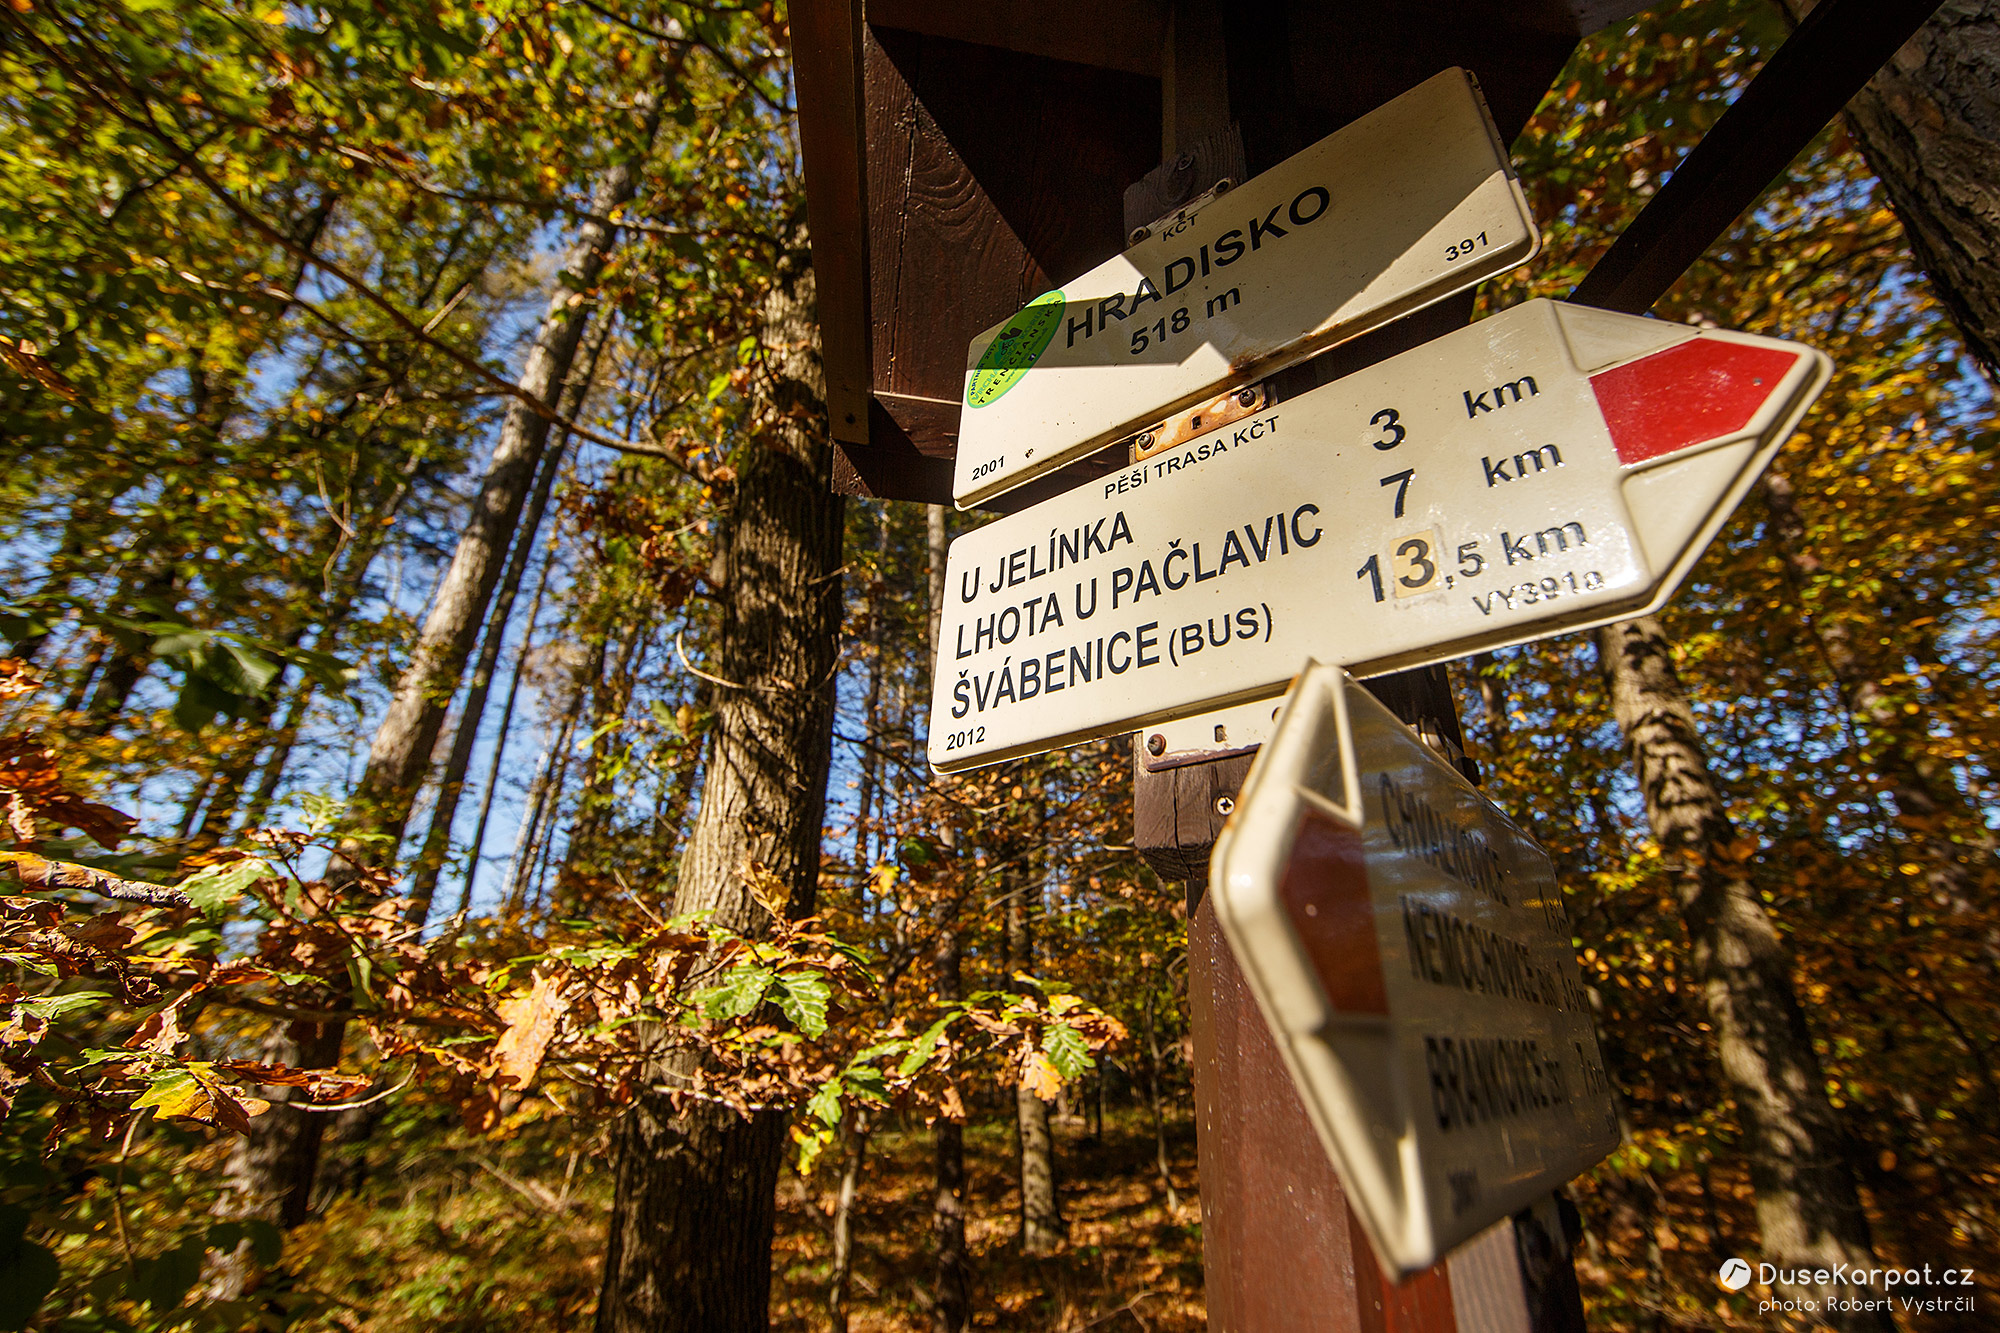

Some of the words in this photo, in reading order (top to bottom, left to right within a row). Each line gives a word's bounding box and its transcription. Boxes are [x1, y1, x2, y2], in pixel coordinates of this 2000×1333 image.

[1162, 212, 1199, 242] KČT
[1444, 231, 1491, 262] 391
[1066, 187, 1331, 349] HRADISKO
[1130, 309, 1190, 356] 518
[1206, 286, 1242, 319] m
[961, 566, 981, 604] U
[989, 511, 1134, 595] JELÍNKA
[1370, 408, 1406, 452] 3
[1463, 375, 1540, 419] km
[971, 456, 1006, 481] 2001
[1104, 467, 1149, 500] PĚŠÍ
[1154, 441, 1229, 477] TRASA
[1233, 415, 1280, 454] KČT
[955, 591, 1064, 661] LHOTA
[1075, 577, 1097, 621] U
[1111, 503, 1324, 610] PAČLAVIC
[1380, 468, 1417, 519] 7
[1481, 442, 1565, 488] km
[950, 620, 1161, 720] ŠVÁBENICE
[1168, 603, 1274, 667] (BUS)
[1357, 538, 1489, 602] 13,5
[1501, 520, 1588, 566] km
[946, 726, 986, 751] 2012
